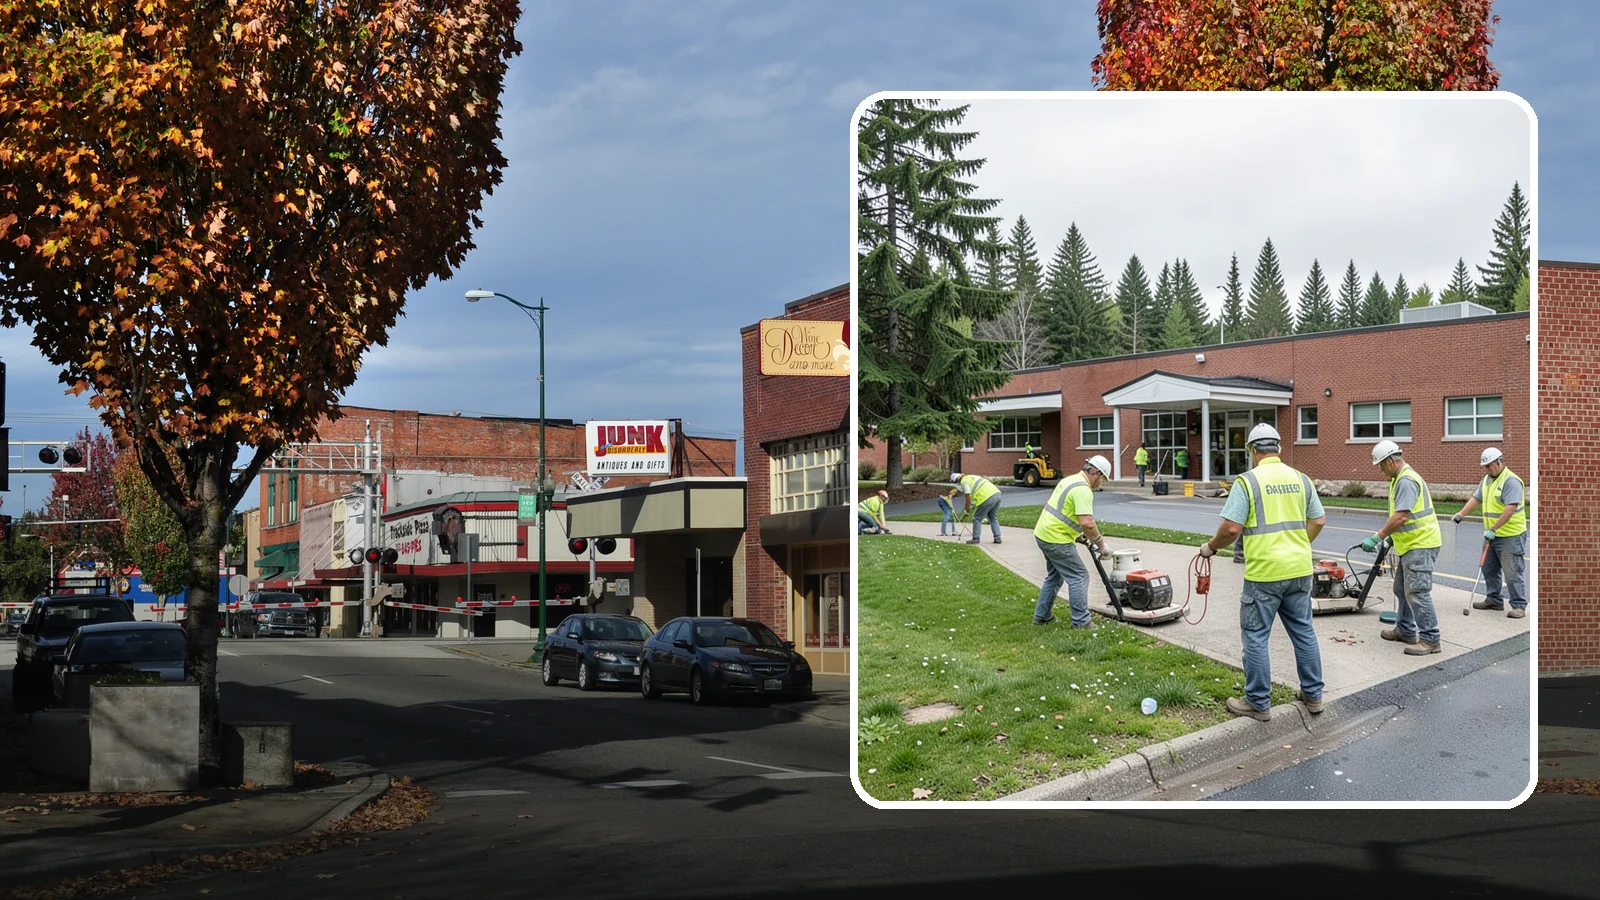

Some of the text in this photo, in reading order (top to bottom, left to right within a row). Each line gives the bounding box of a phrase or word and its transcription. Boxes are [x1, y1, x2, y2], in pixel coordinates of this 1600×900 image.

[765, 327, 831, 365] Decor
[595, 425, 665, 457] JUNK
[607, 446, 646, 454] DISORDERLY
[597, 460, 665, 470] ANTIQUES AND GIFTS
[390, 519, 429, 539] Trackside Pizza
